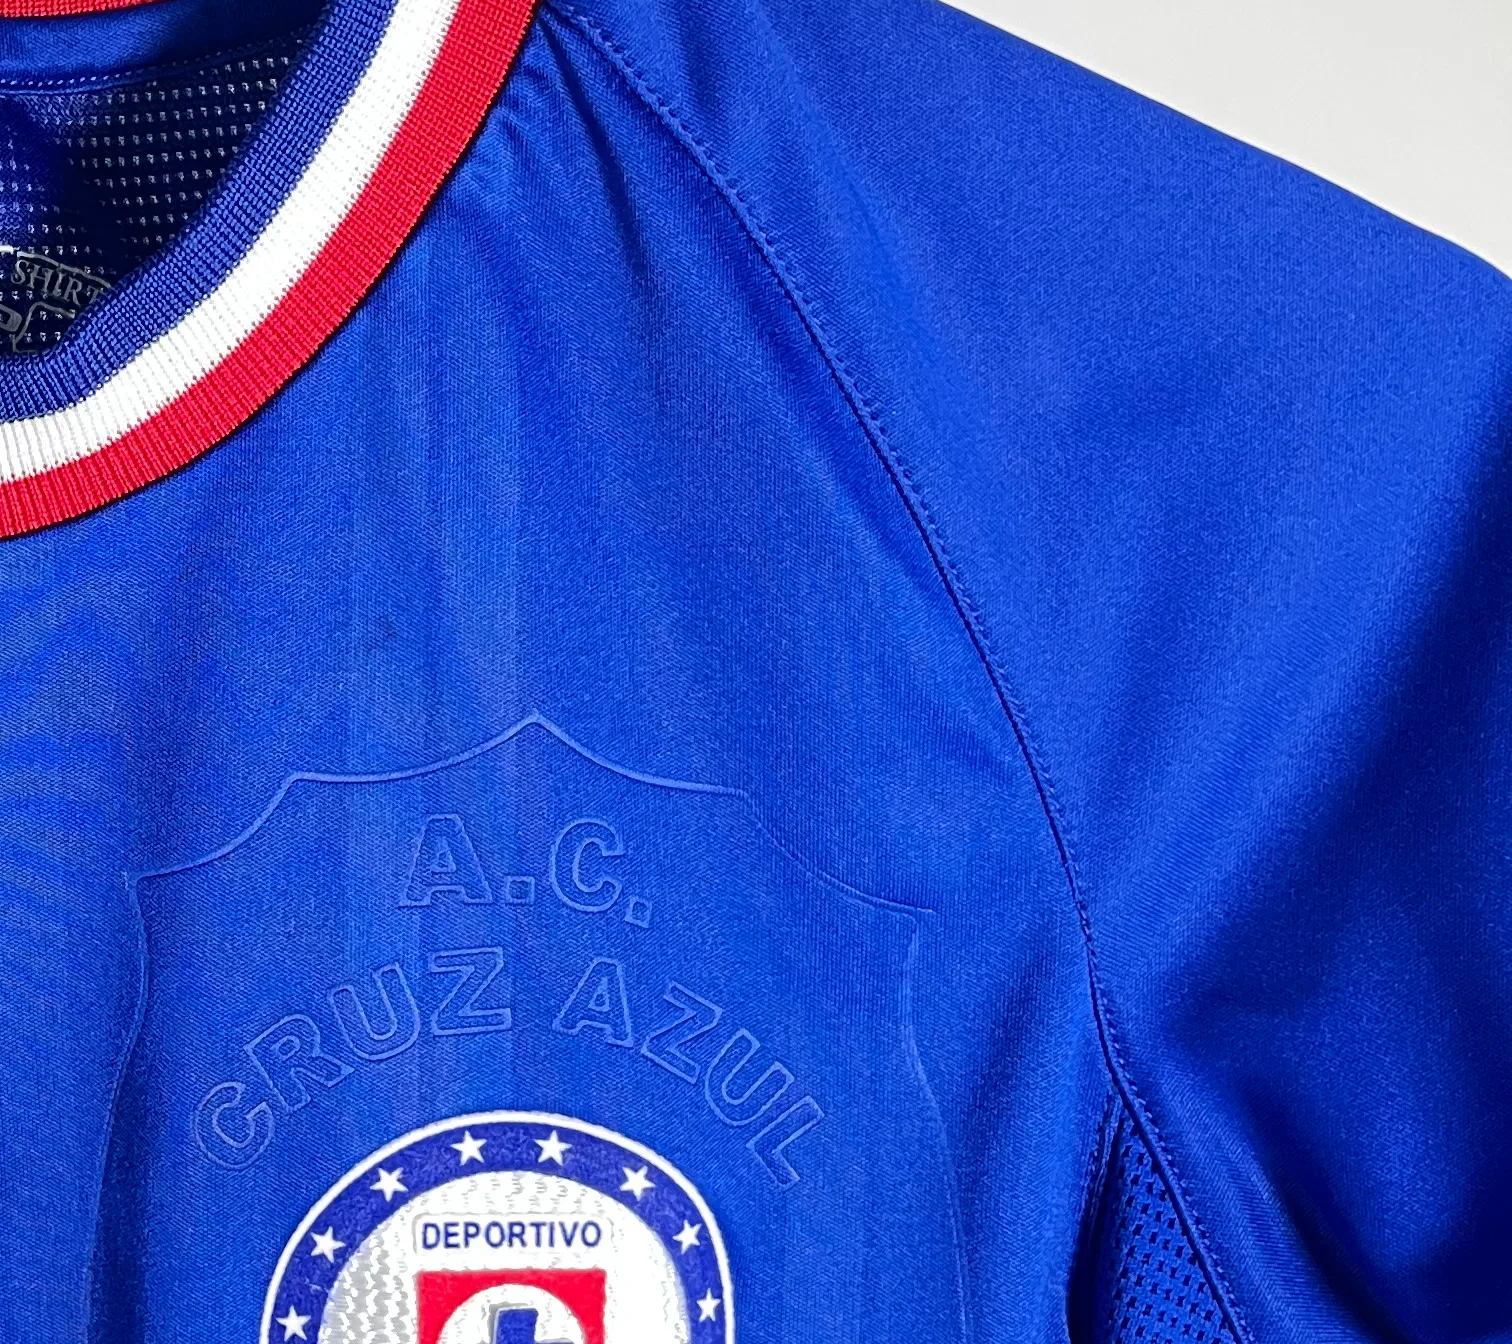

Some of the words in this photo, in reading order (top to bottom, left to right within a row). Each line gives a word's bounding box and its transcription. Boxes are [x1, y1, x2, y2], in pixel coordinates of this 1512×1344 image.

[398, 813, 655, 928] A.C.
[193, 947, 514, 1170] CRUZ
[551, 957, 826, 1188] AZUL
[421, 1220, 603, 1251] DEPORTIVO
